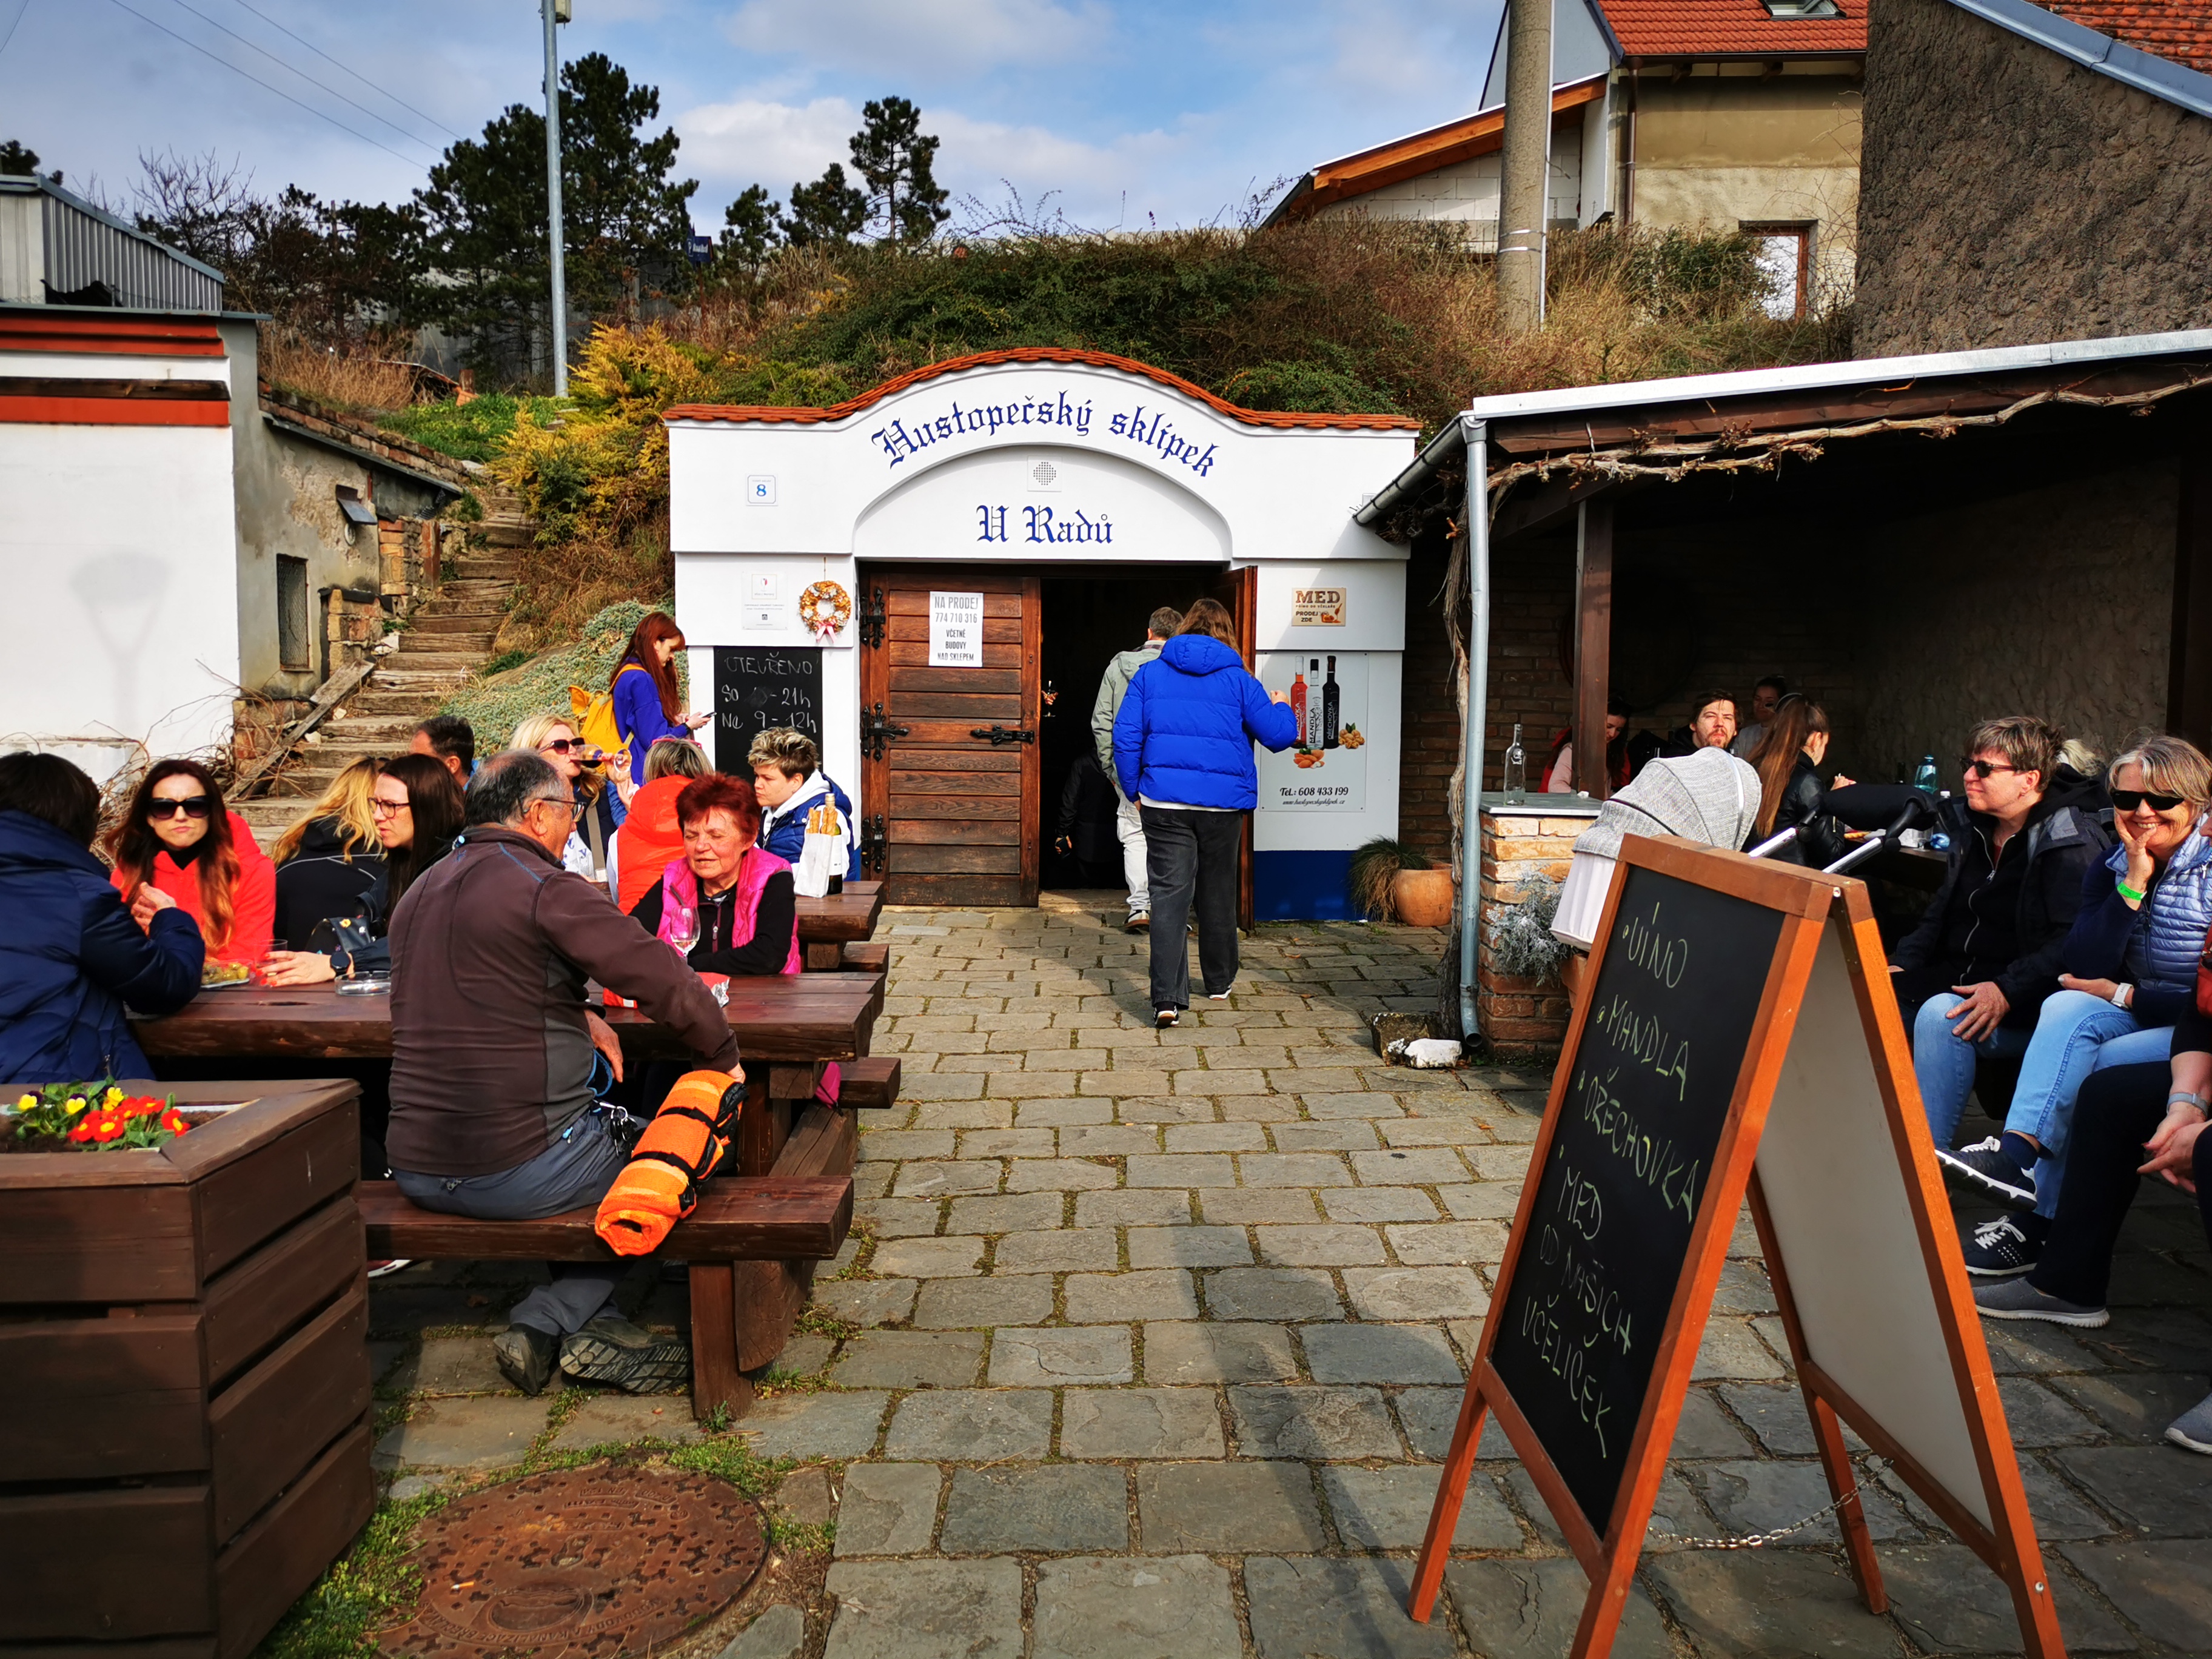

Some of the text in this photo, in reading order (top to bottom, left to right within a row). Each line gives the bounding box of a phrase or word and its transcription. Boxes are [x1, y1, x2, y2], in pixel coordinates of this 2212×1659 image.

[871, 390, 1221, 477] Hustopečský sklípek
[756, 484, 766, 497] 8
[976, 504, 1113, 543] U Radů
[934, 596, 978, 609] NA PRODEJ
[1296, 591, 1340, 603] MED
[935, 612, 977, 623] 774 710 316
[945, 641, 967, 649] BUDOVY
[950, 652, 974, 661] SKLEPEM
[782, 687, 811, 708] 21h
[754, 711, 765, 728] 9
[786, 712, 817, 733] 12h
[1298, 787, 1315, 796] 608
[1317, 787, 1333, 796] 433
[1335, 786, 1349, 796] 199
[1606, 994, 1688, 1101] MANDLA
[1585, 1067, 1699, 1224] OŘECHOVKA
[1558, 1167, 1602, 1240] MED
[1540, 1224, 1559, 1265] OD
[1523, 1294, 1610, 1458] VČELIČEK
